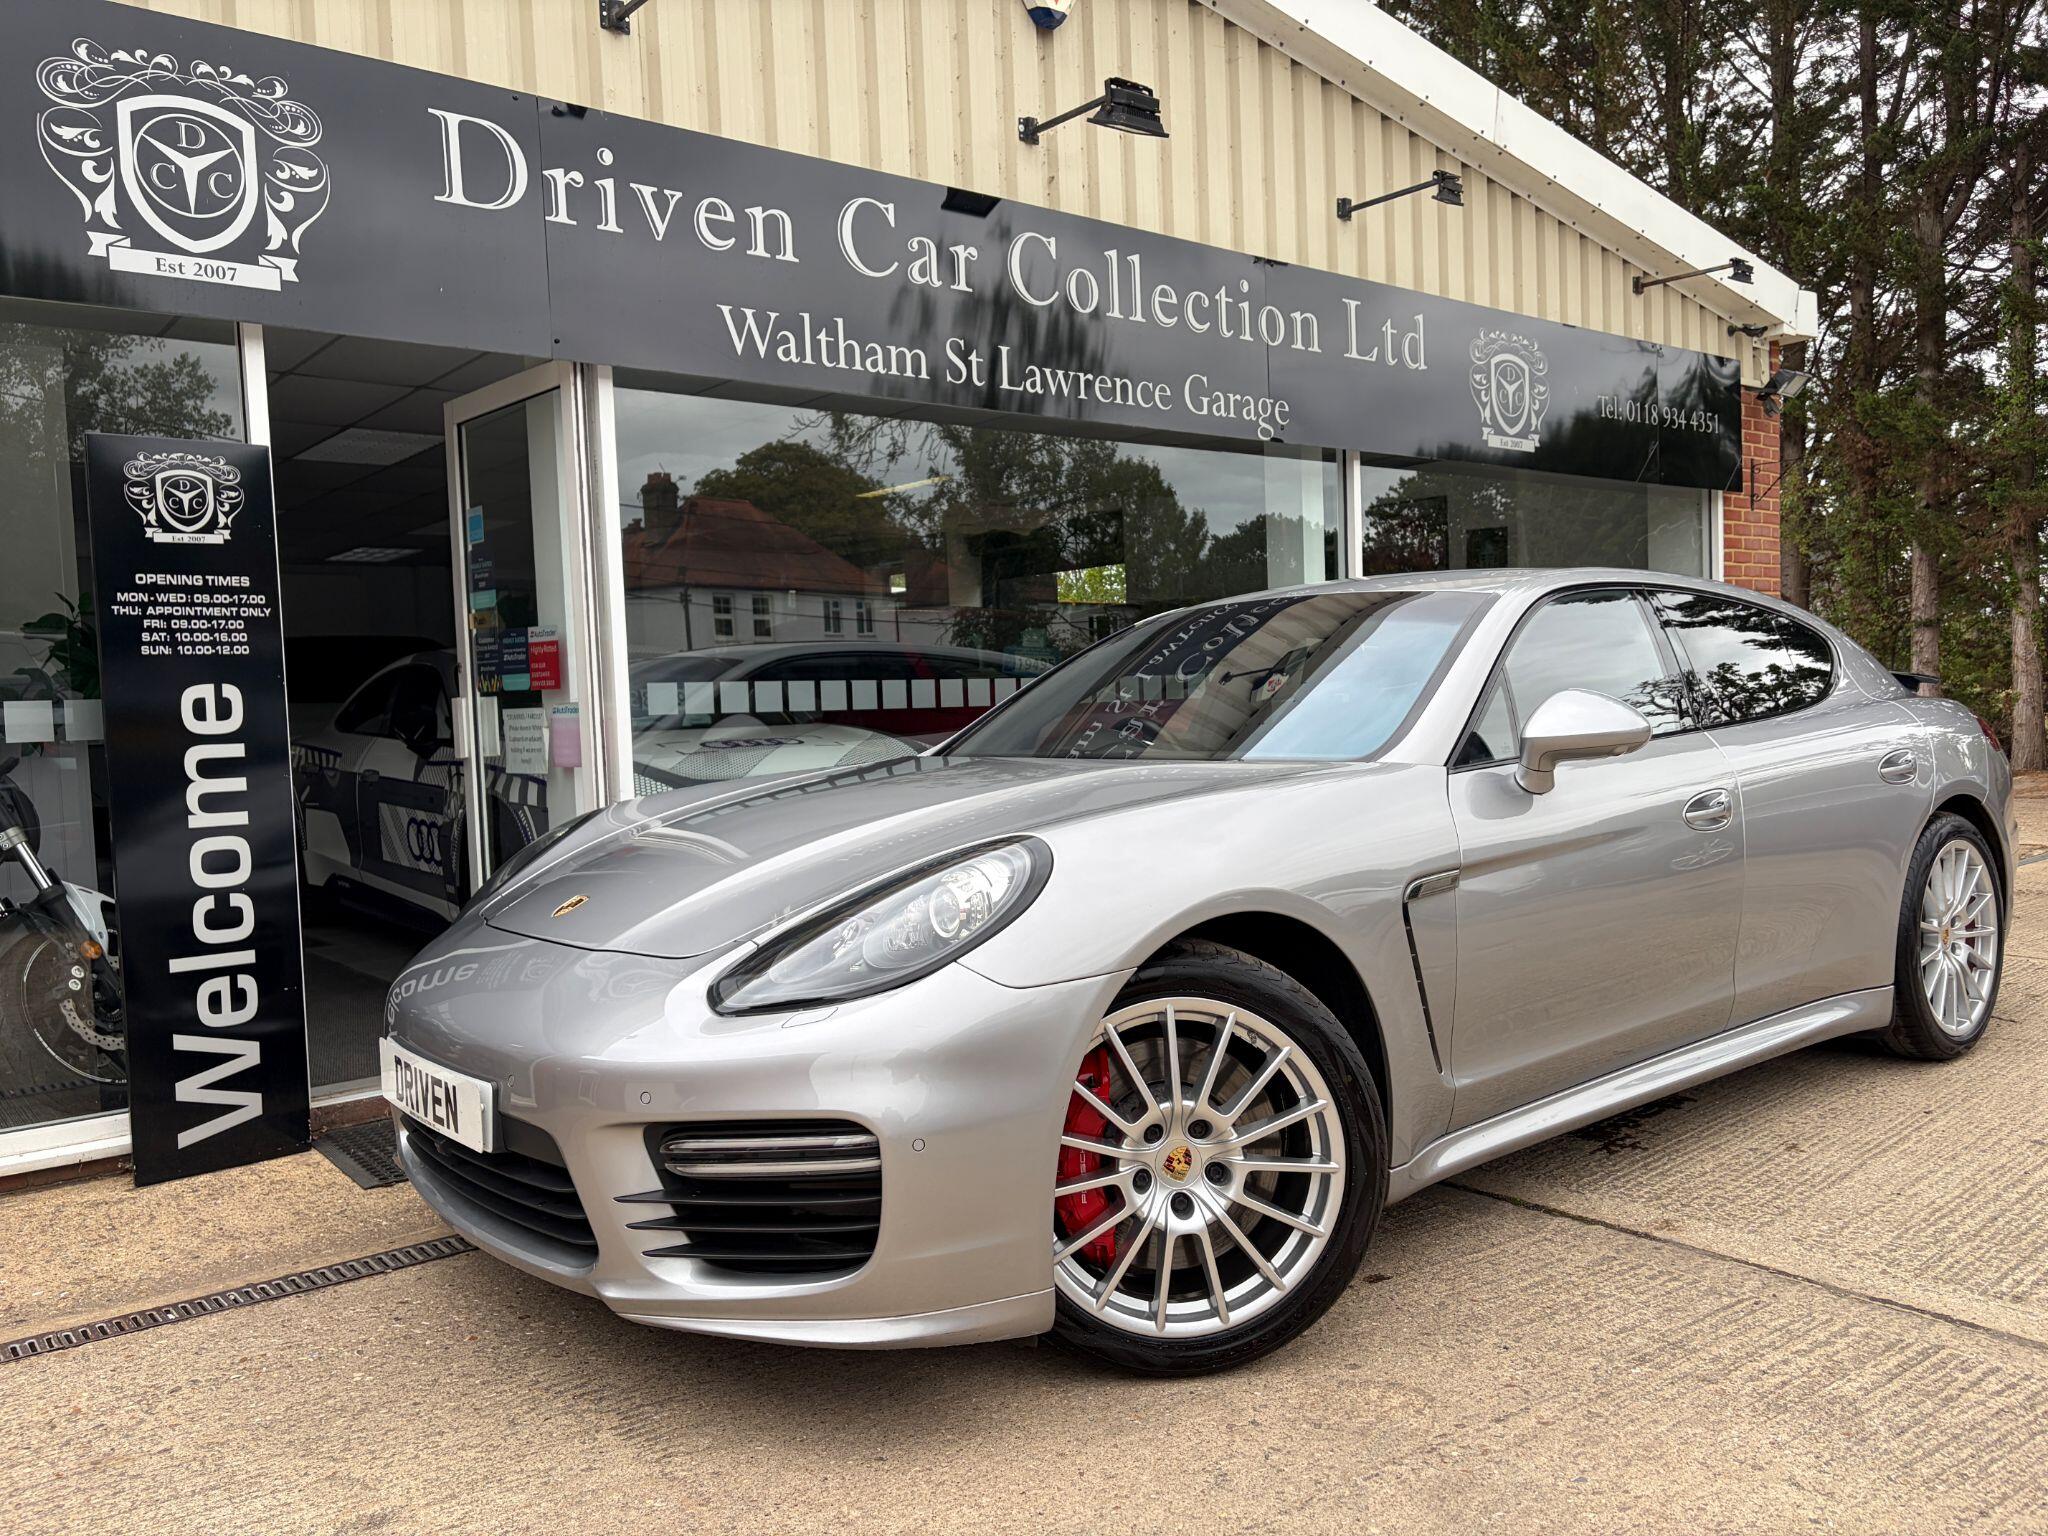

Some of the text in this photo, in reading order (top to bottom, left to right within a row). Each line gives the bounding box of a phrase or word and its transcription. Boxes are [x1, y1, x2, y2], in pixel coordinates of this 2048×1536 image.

[176, 121, 206, 149] D
[150, 162, 234, 199] C C
[427, 107, 1428, 371] Driven Car Collection Ltd
[155, 257, 238, 282] Est 2007
[716, 303, 1290, 440] Waltham St Lawrence Garage
[1506, 367, 1516, 381] D
[1598, 395, 1719, 434] Tel: 0118 934 4351
[179, 480, 190, 491] D
[168, 497, 203, 510] C C
[135, 573, 250, 587] OPENING TIMES
[111, 605, 271, 617] THU: APPOINTMENT ONLY
[143, 619, 244, 630] FRI: 09.00-17.00
[141, 632, 248, 643] SAT: 10.00-16.00
[141, 645, 250, 656] SUN: 10.00-12.00
[169, 683, 263, 1150] Welcome
[394, 1054, 459, 1134] DRIVEN
